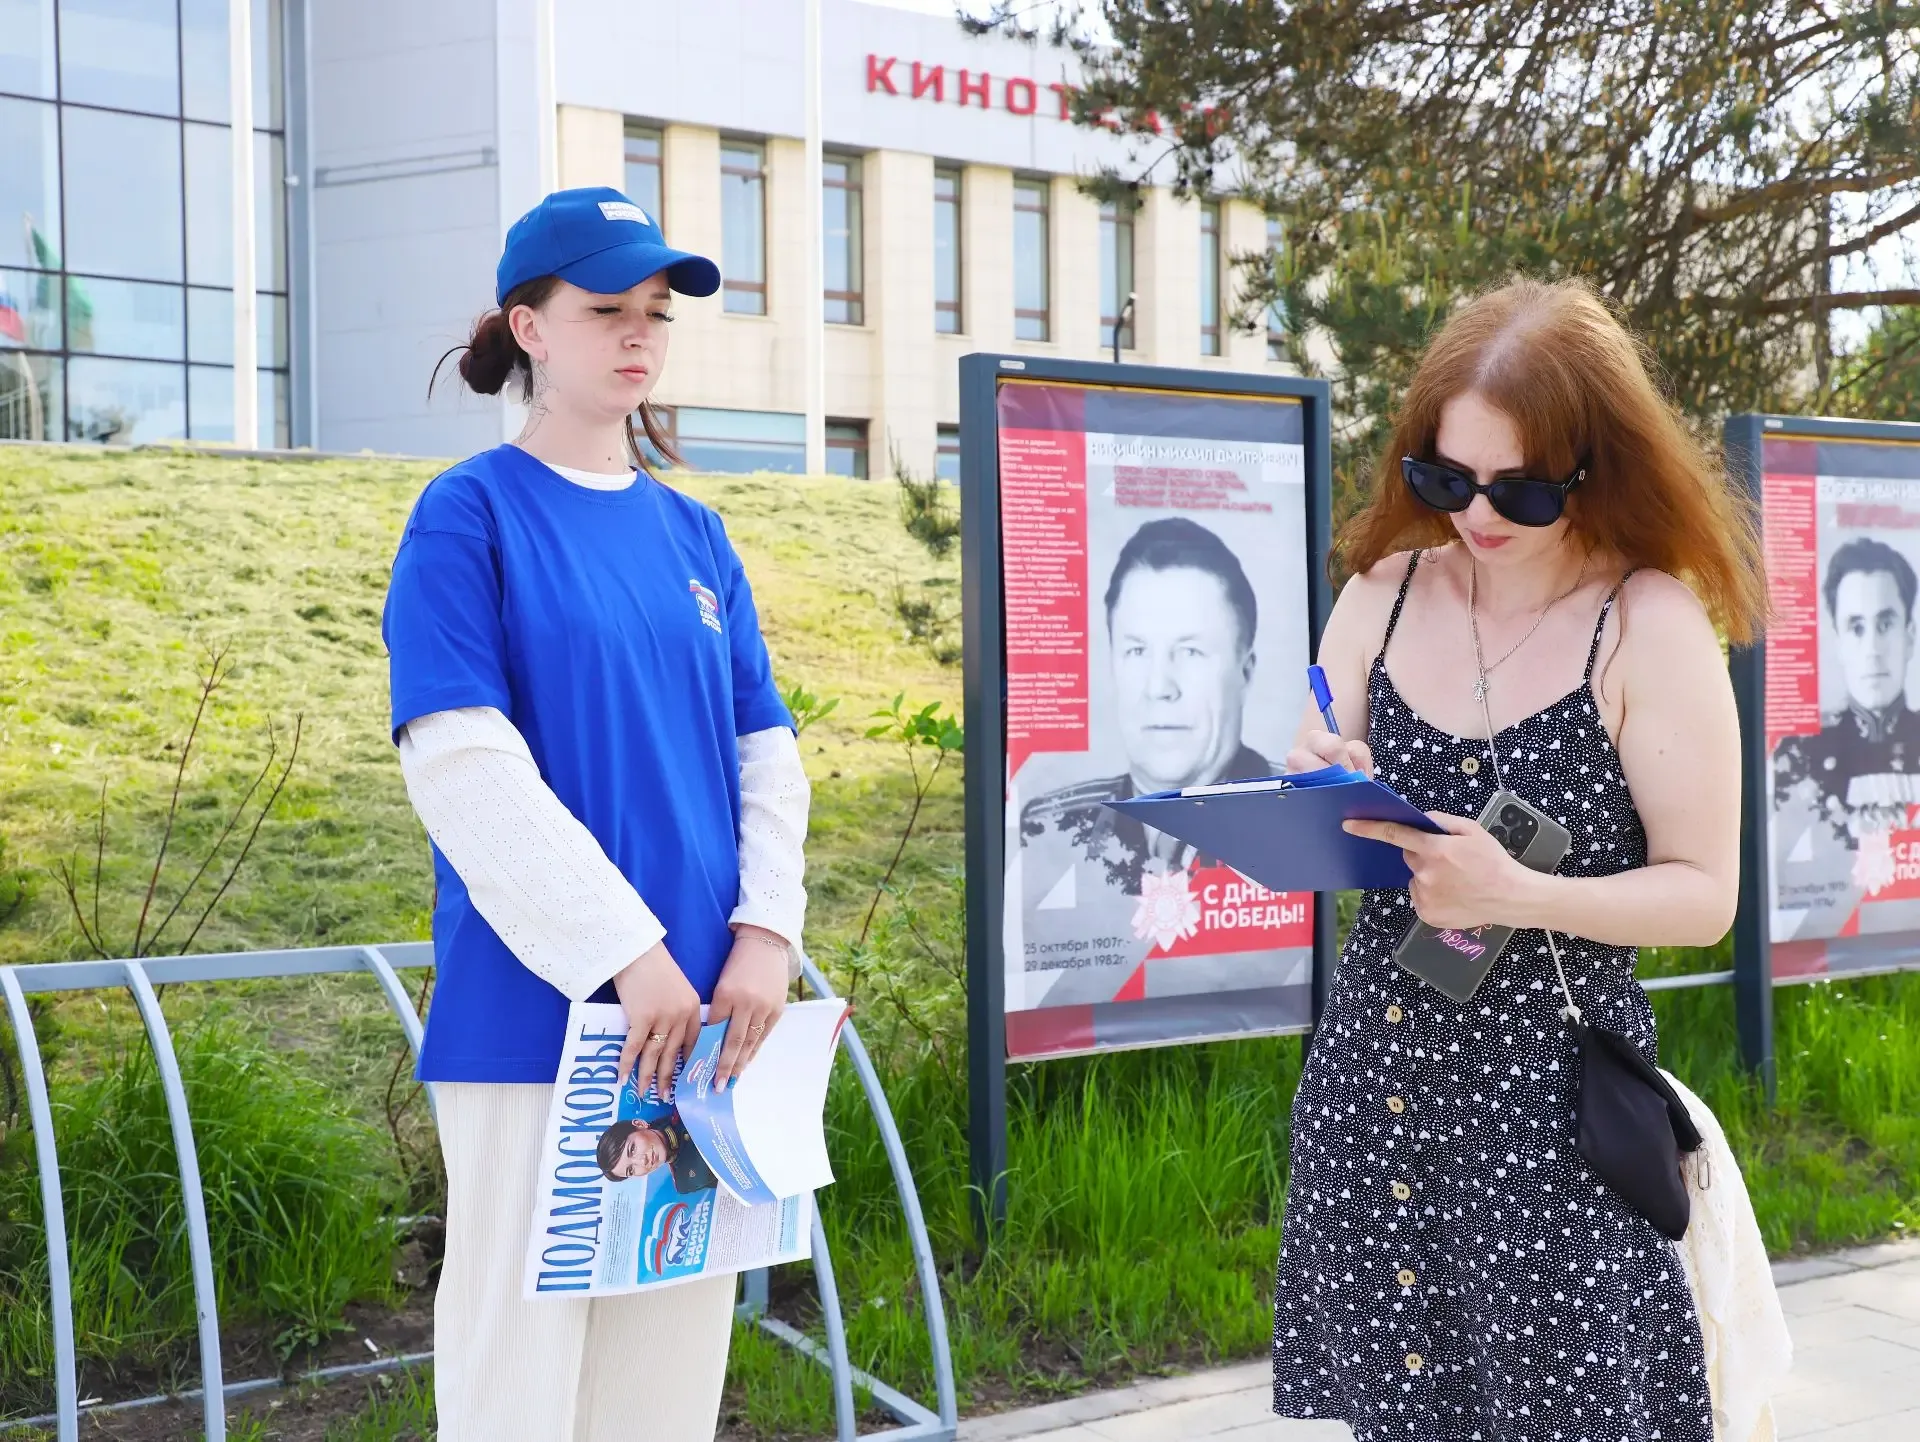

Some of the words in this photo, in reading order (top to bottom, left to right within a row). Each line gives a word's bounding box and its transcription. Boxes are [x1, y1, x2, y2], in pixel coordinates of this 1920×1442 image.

[1091, 442, 1155, 461] НИКИШИН
[1159, 446, 1216, 464] МИХАИЛ
[1218, 449, 1298, 467] ДМИТРИЕВИЧ
[1203, 884, 1218, 905] С
[1204, 904, 1305, 931] ПОБЕДЫ!
[1025, 944, 1037, 955] 25
[1040, 940, 1089, 955] октября
[1423, 928, 1486, 961] ream
[1040, 957, 1091, 971] декабря
[1094, 955, 1128, 967] 1982г.
[536, 1024, 627, 1291] ПОДМОСКОВЬЕ
[684, 1203, 703, 1266] ЕДИНАЯ
[694, 1200, 711, 1265] РОССИЯ
